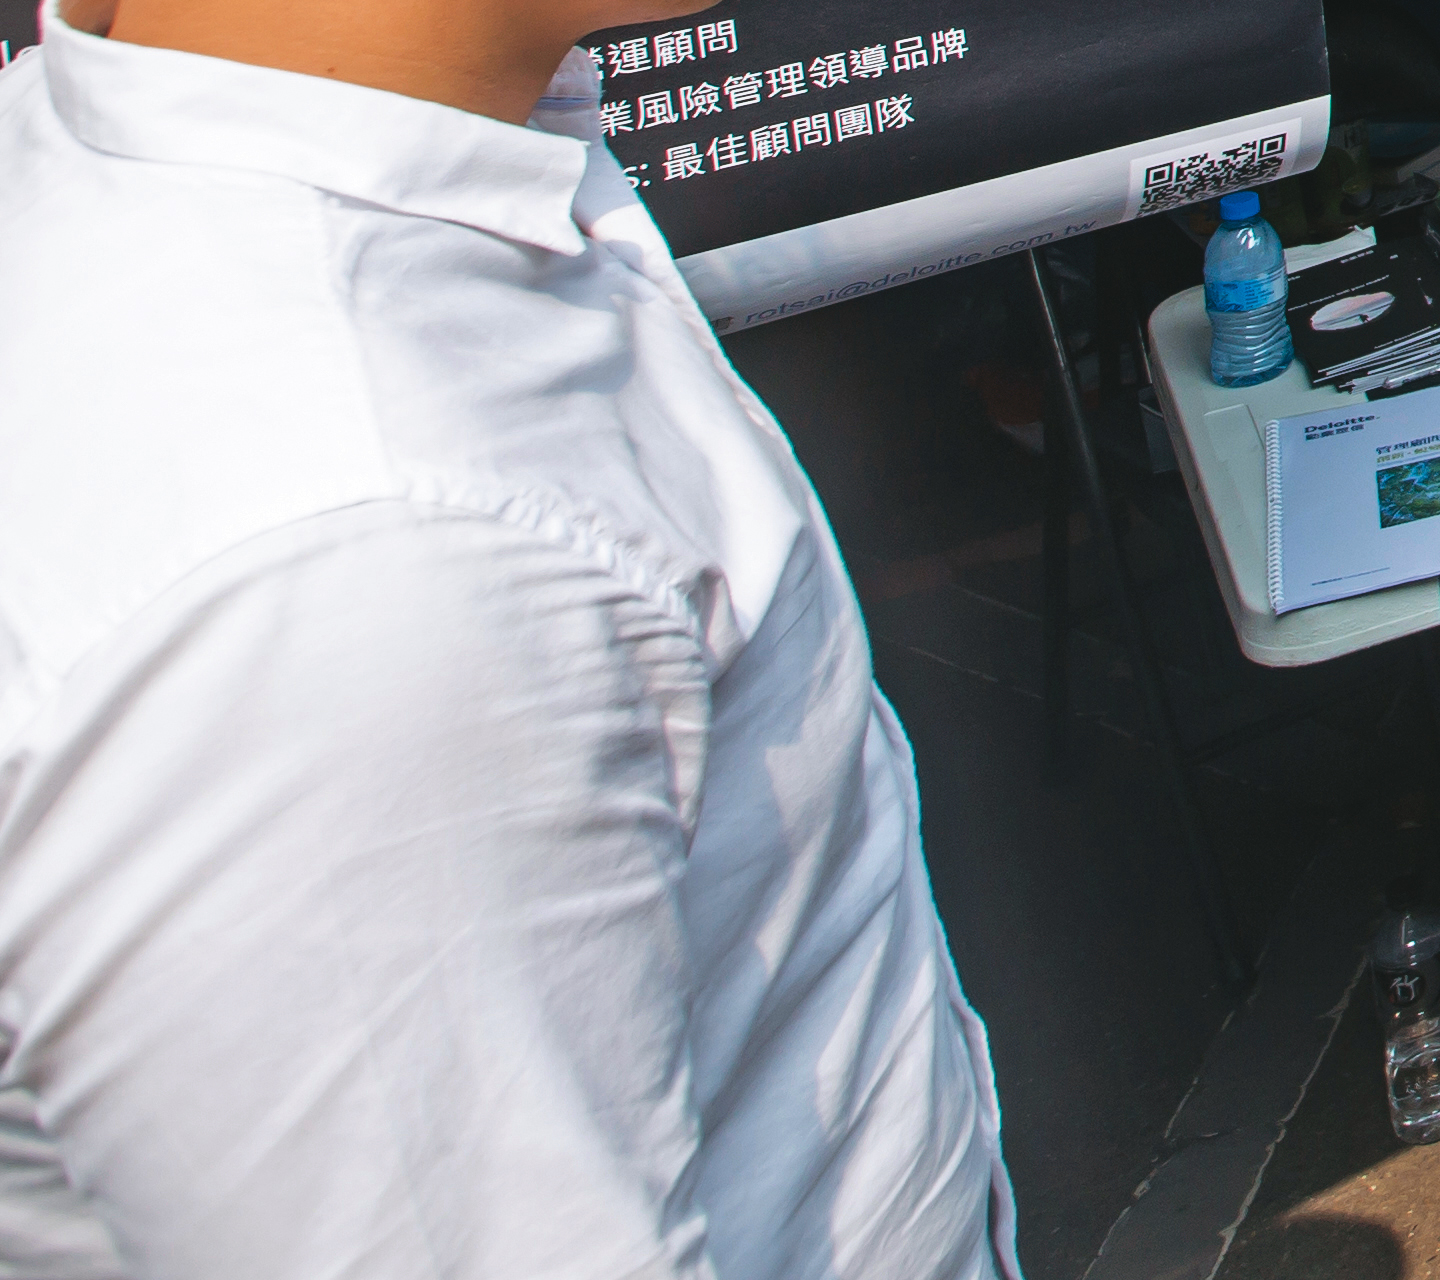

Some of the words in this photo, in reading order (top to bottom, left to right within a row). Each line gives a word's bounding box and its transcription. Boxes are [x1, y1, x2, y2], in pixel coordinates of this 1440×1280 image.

[662, 93, 915, 183] 最佳顧問團隊
